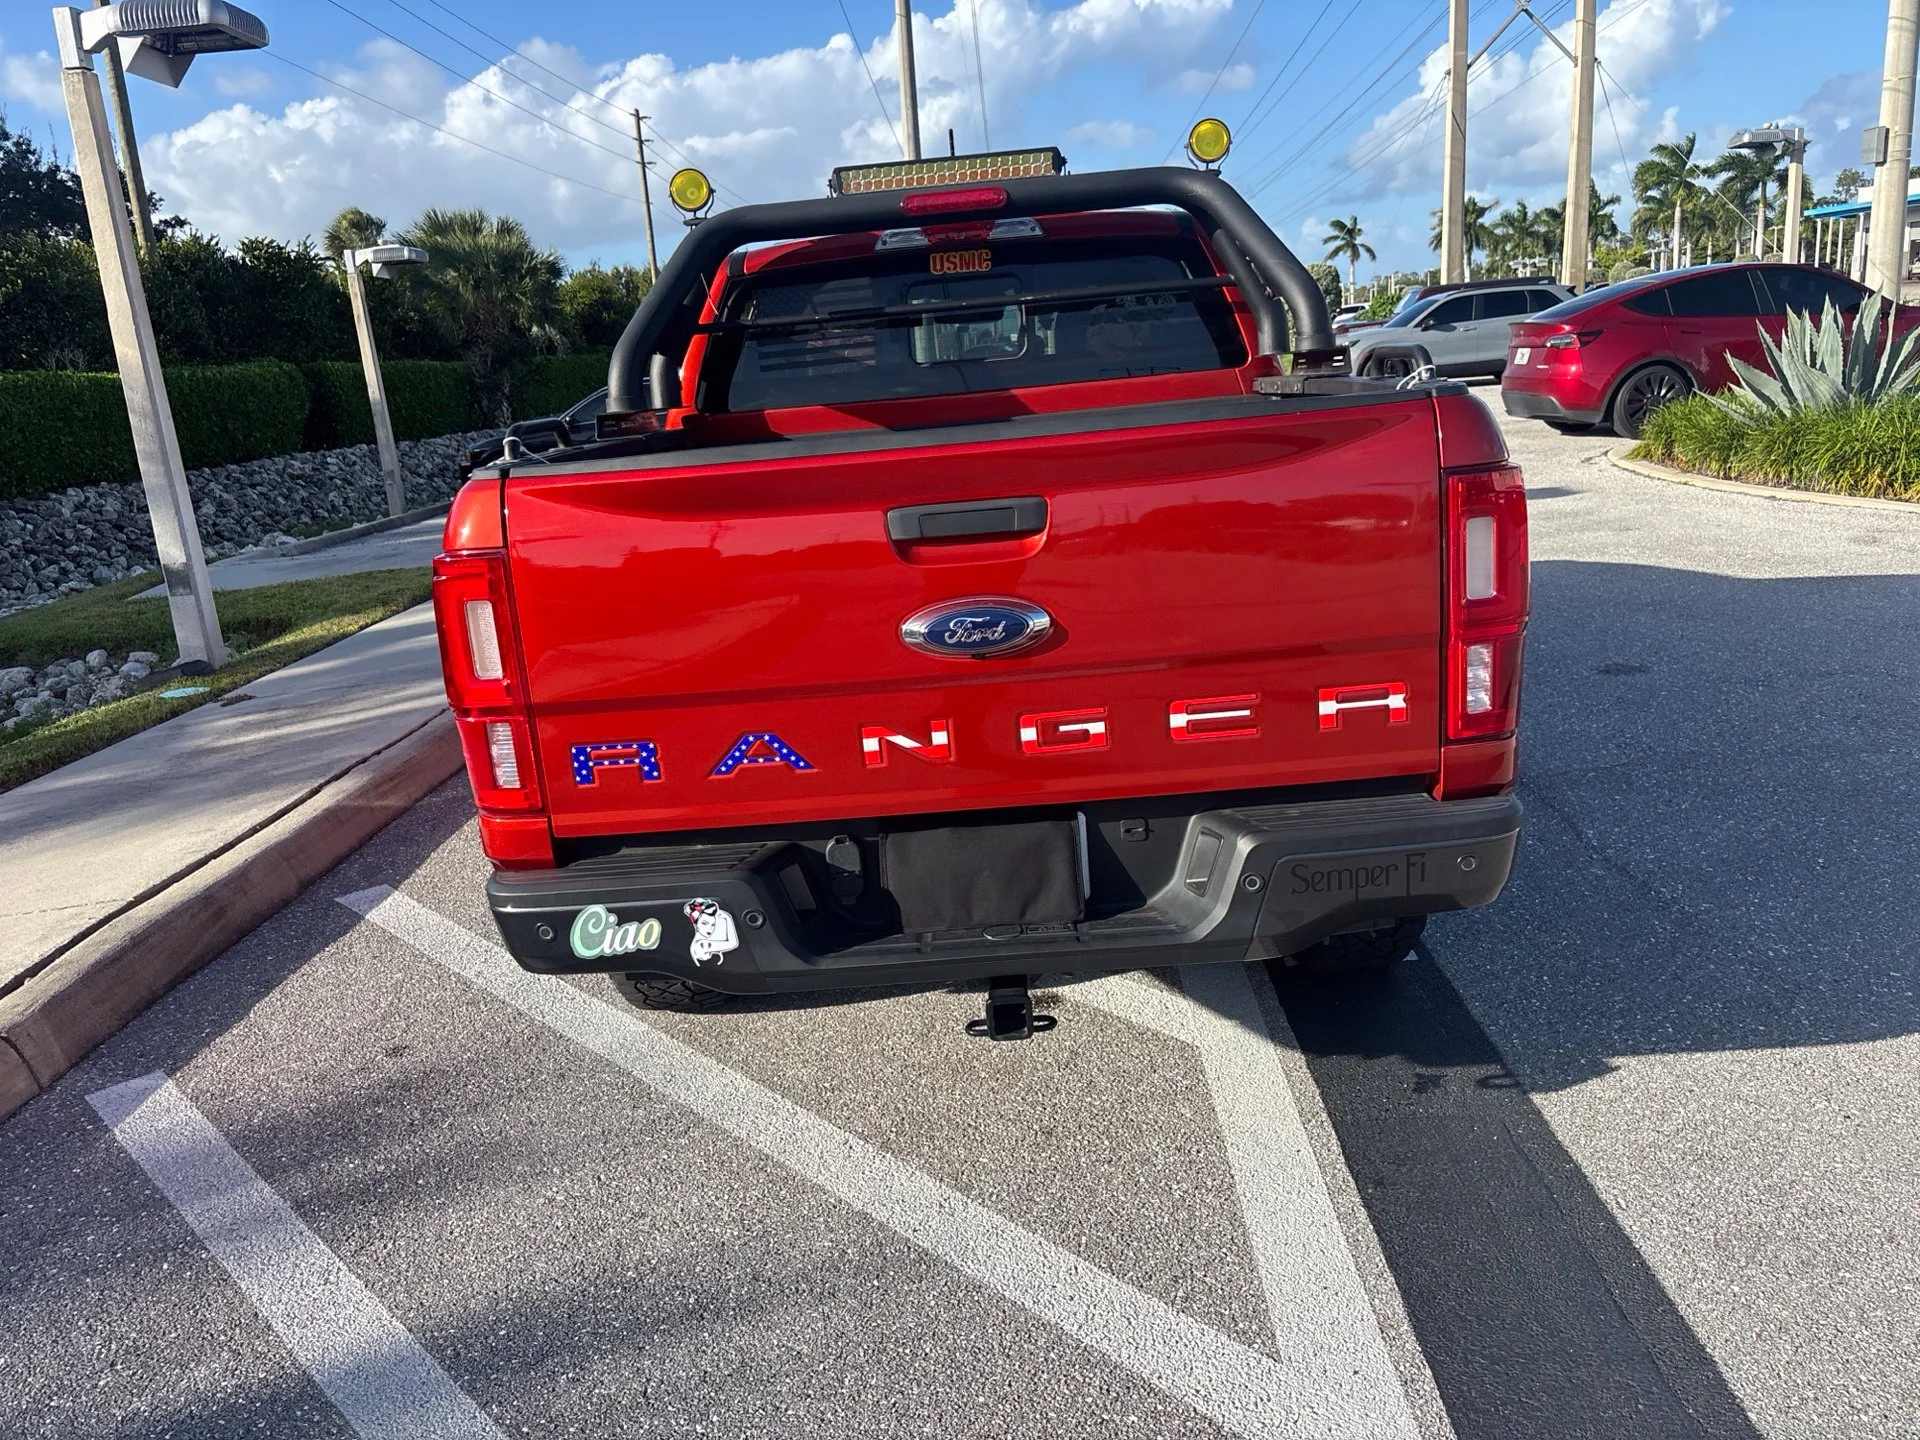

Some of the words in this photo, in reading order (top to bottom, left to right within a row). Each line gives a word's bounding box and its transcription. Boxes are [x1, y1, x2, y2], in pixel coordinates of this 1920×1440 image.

[931, 250, 991, 274] USMC
[945, 617, 1005, 643] Ford
[570, 682, 1411, 787] RANGER
[1291, 863, 1398, 903] Semper
[1405, 851, 1426, 898] Fi
[571, 904, 661, 958] Ciao
